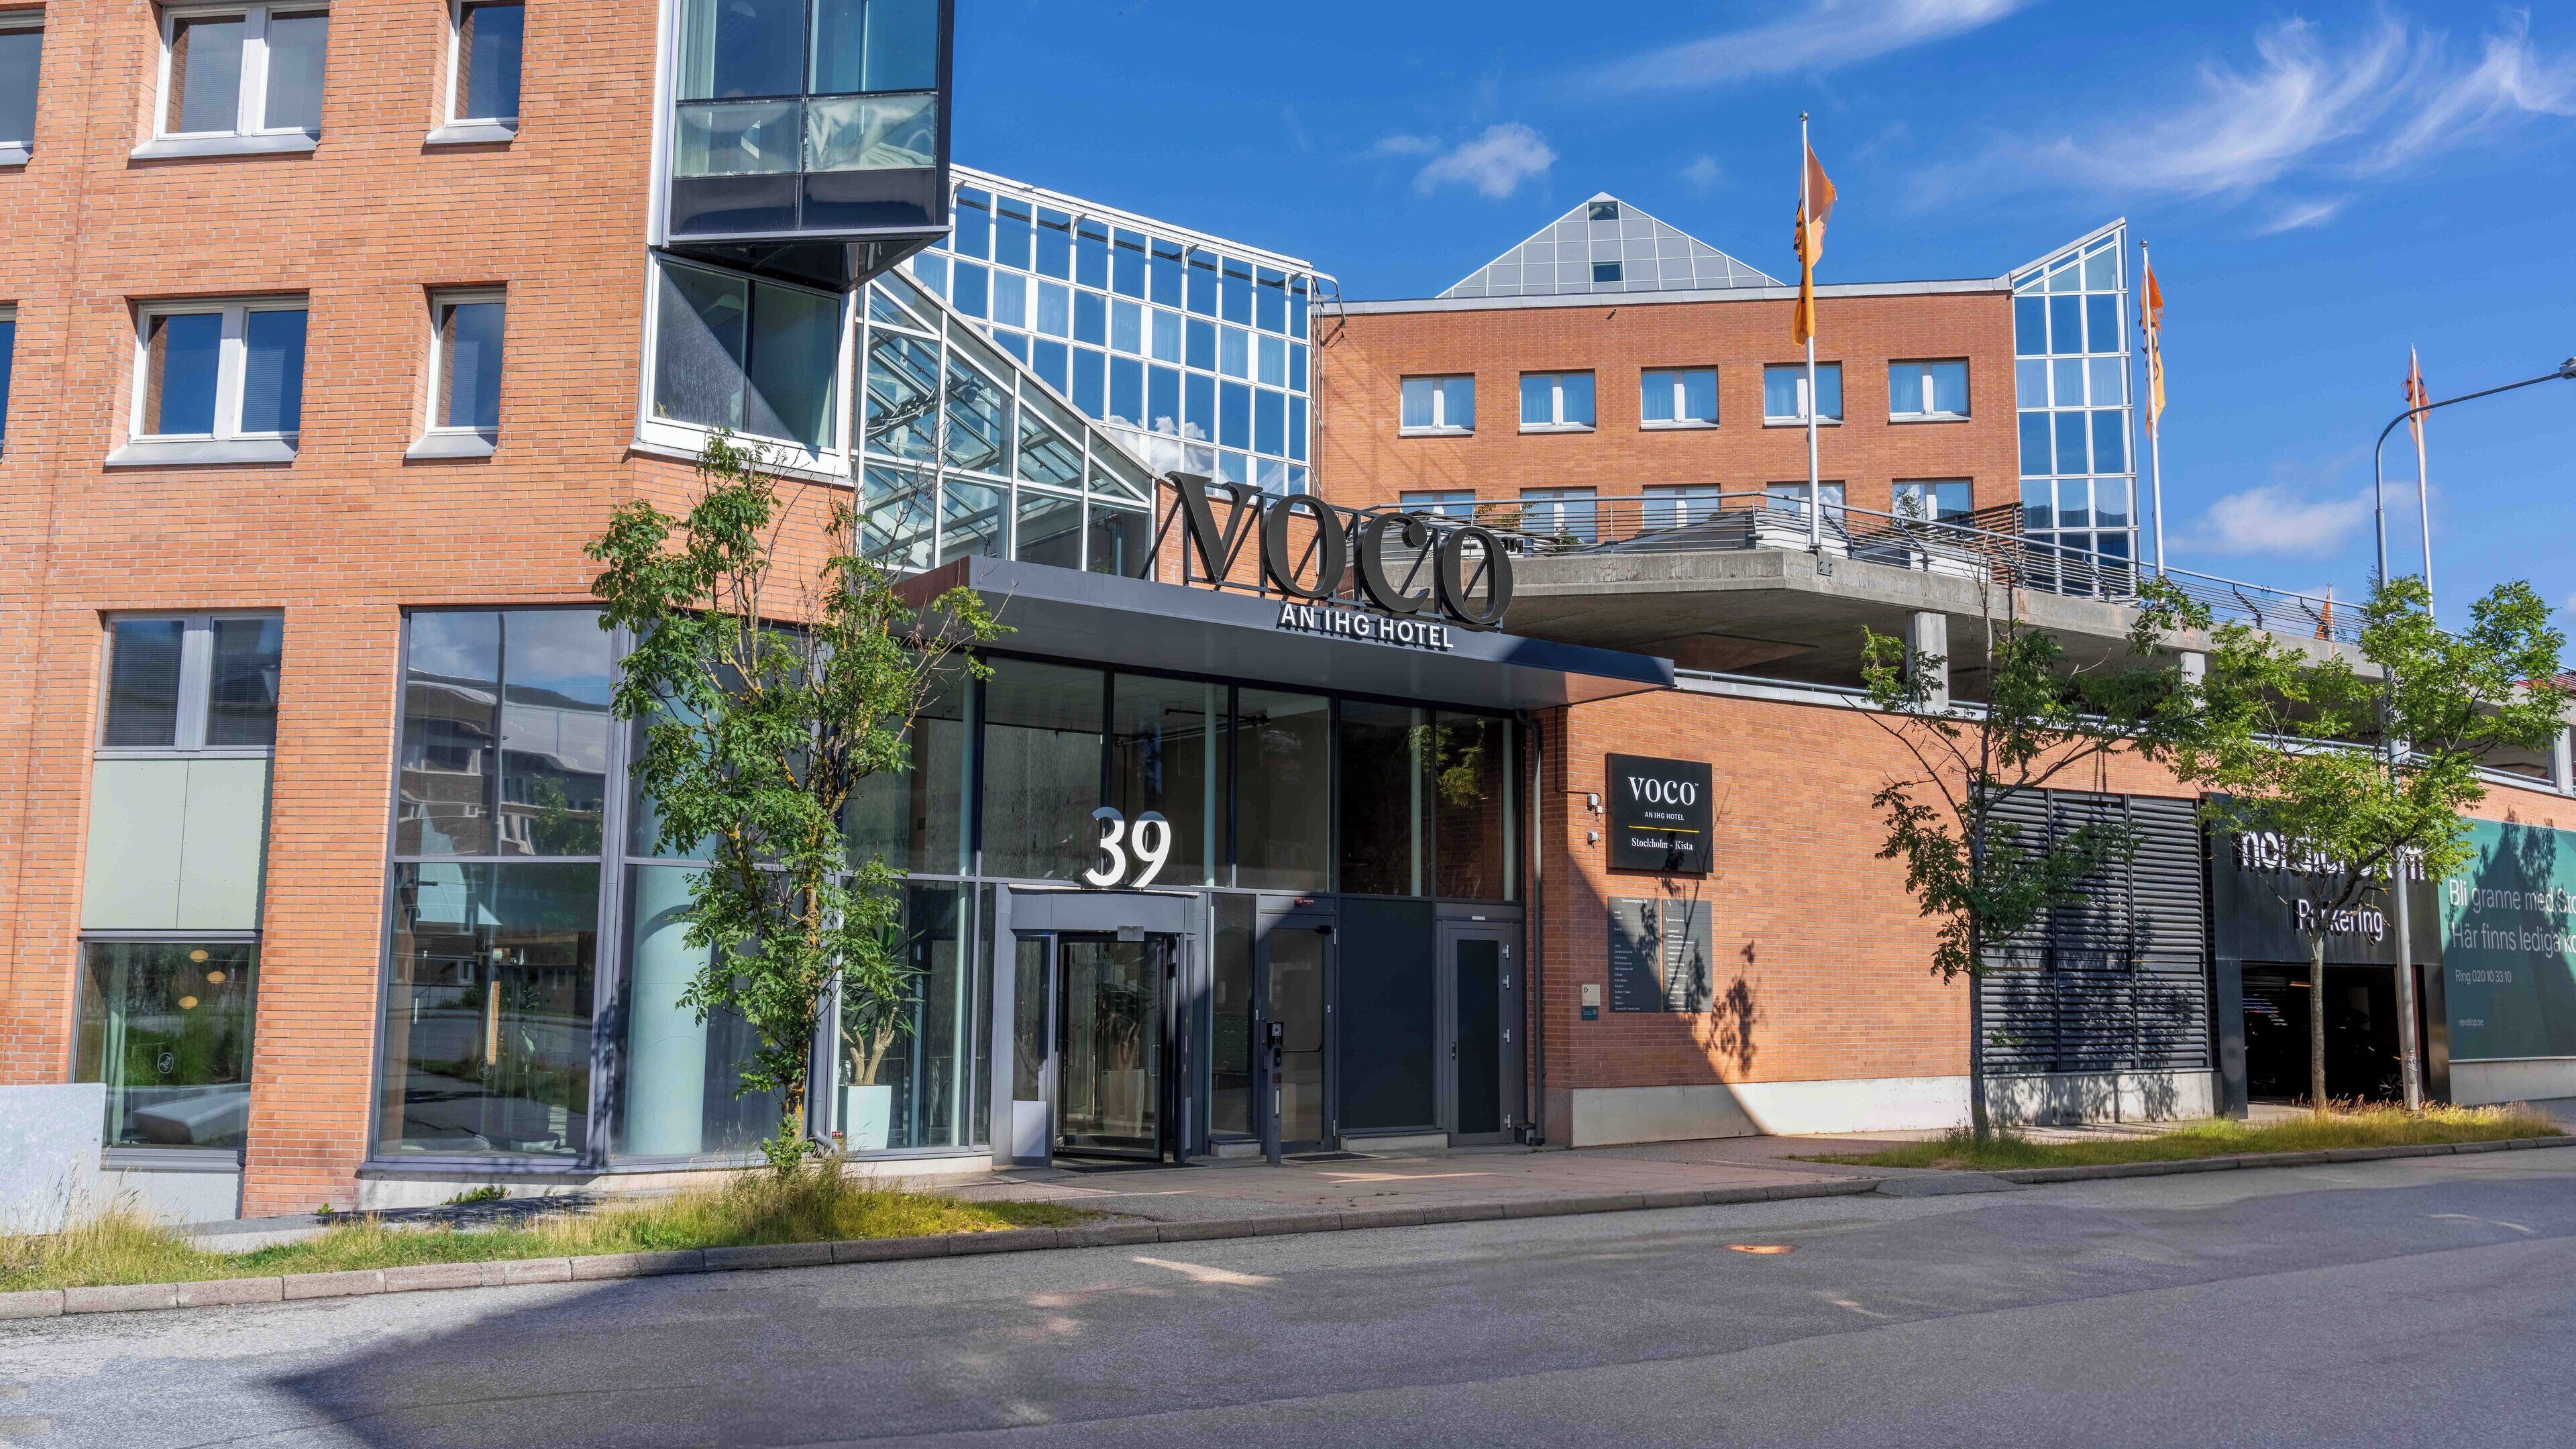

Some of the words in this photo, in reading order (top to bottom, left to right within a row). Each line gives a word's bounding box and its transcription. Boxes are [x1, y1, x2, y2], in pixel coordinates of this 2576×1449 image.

[1281, 604, 1315, 628] AN
[1325, 609, 1369, 635] IHG
[1380, 618, 1454, 648] HOTEL
[1083, 806, 1171, 887] 39
[1631, 837, 1668, 849] Stockholm
[1675, 840, 1693, 851] Kista
[2449, 879, 2468, 906] Bli
[2471, 887, 2521, 914] granne
[2525, 887, 2555, 912] med
[2451, 922, 2478, 949] Här
[2481, 922, 2516, 951] finns
[2519, 925, 2561, 959] lediga
[2455, 969, 2471, 985] Ring
[2472, 969, 2485, 982] 020
[2486, 970, 2494, 982] 10
[2496, 970, 2504, 982] 33
[2504, 971, 2512, 983] 10
